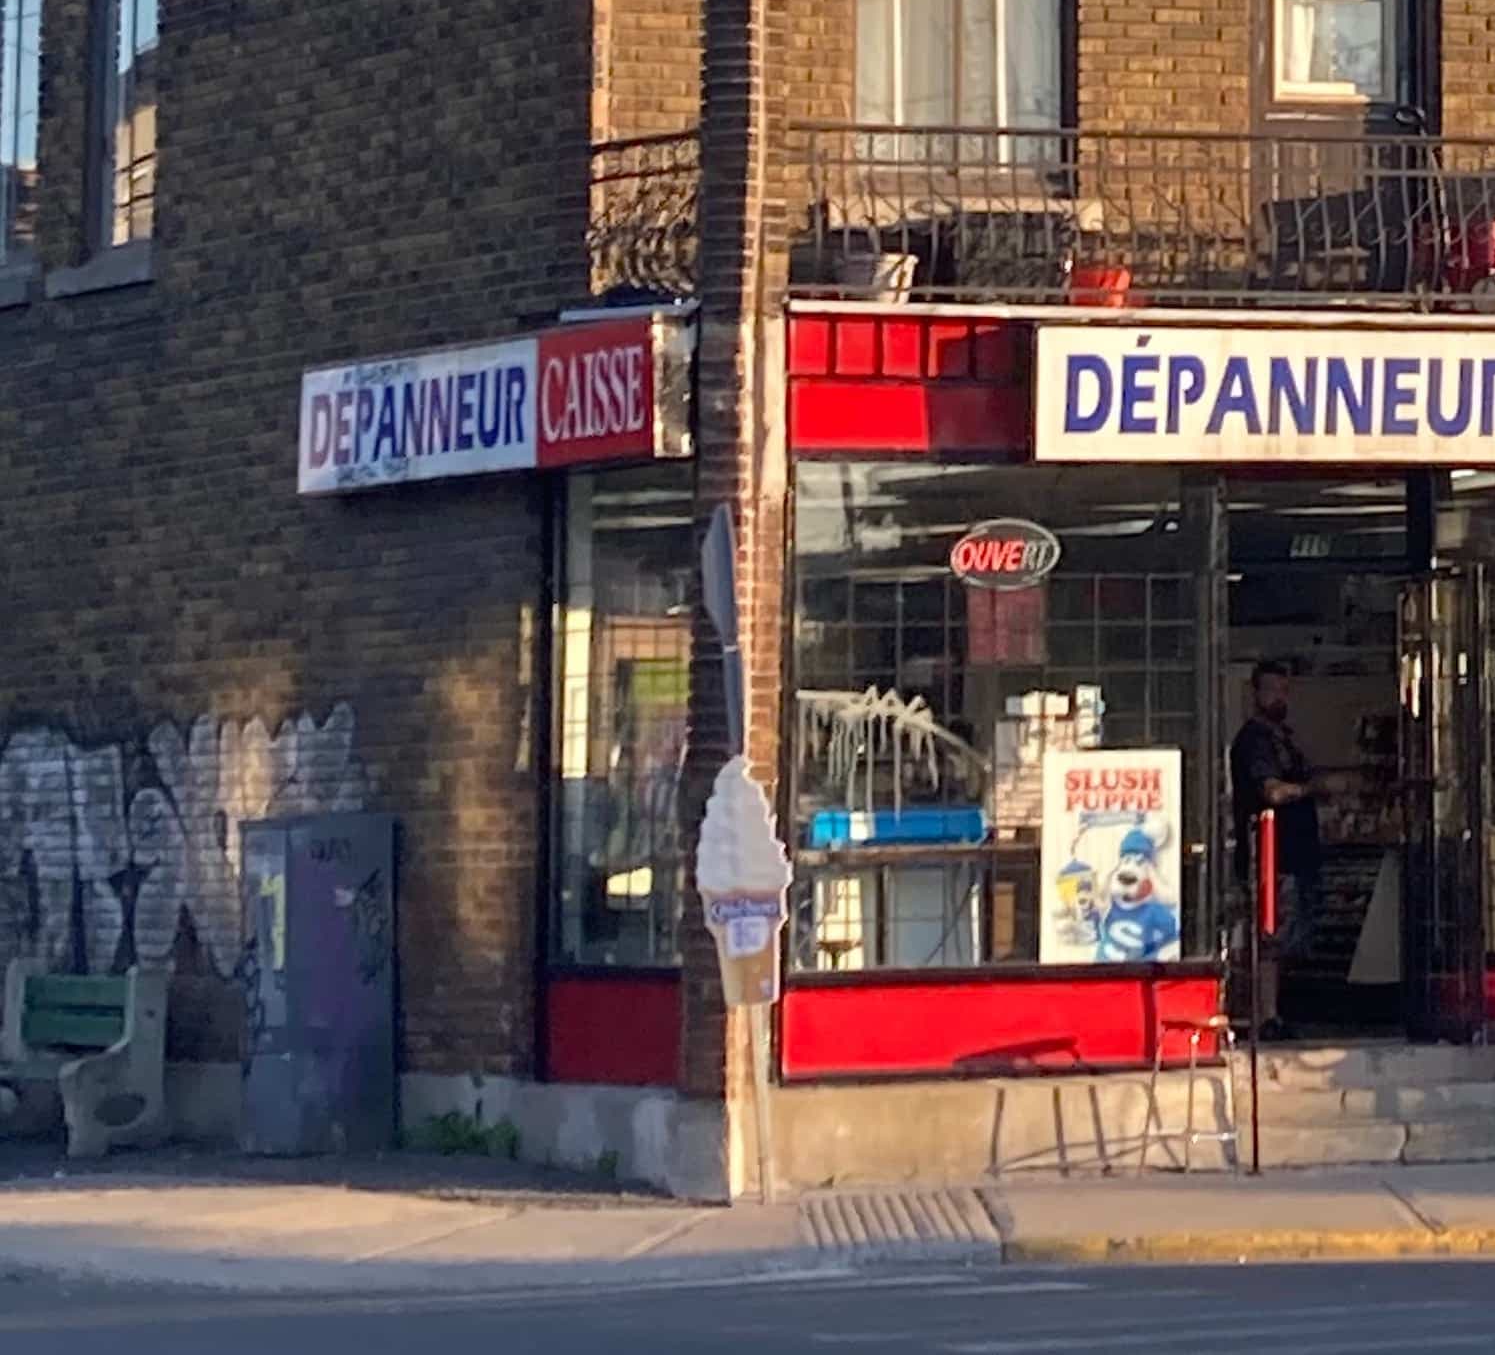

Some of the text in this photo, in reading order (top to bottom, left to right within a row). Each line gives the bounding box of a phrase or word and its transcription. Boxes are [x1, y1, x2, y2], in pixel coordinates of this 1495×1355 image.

[308, 345, 644, 470] DÉPANNEUR CAISSE
[958, 539, 1050, 572] OUVERT
[1064, 768, 1162, 791] SLUSH
